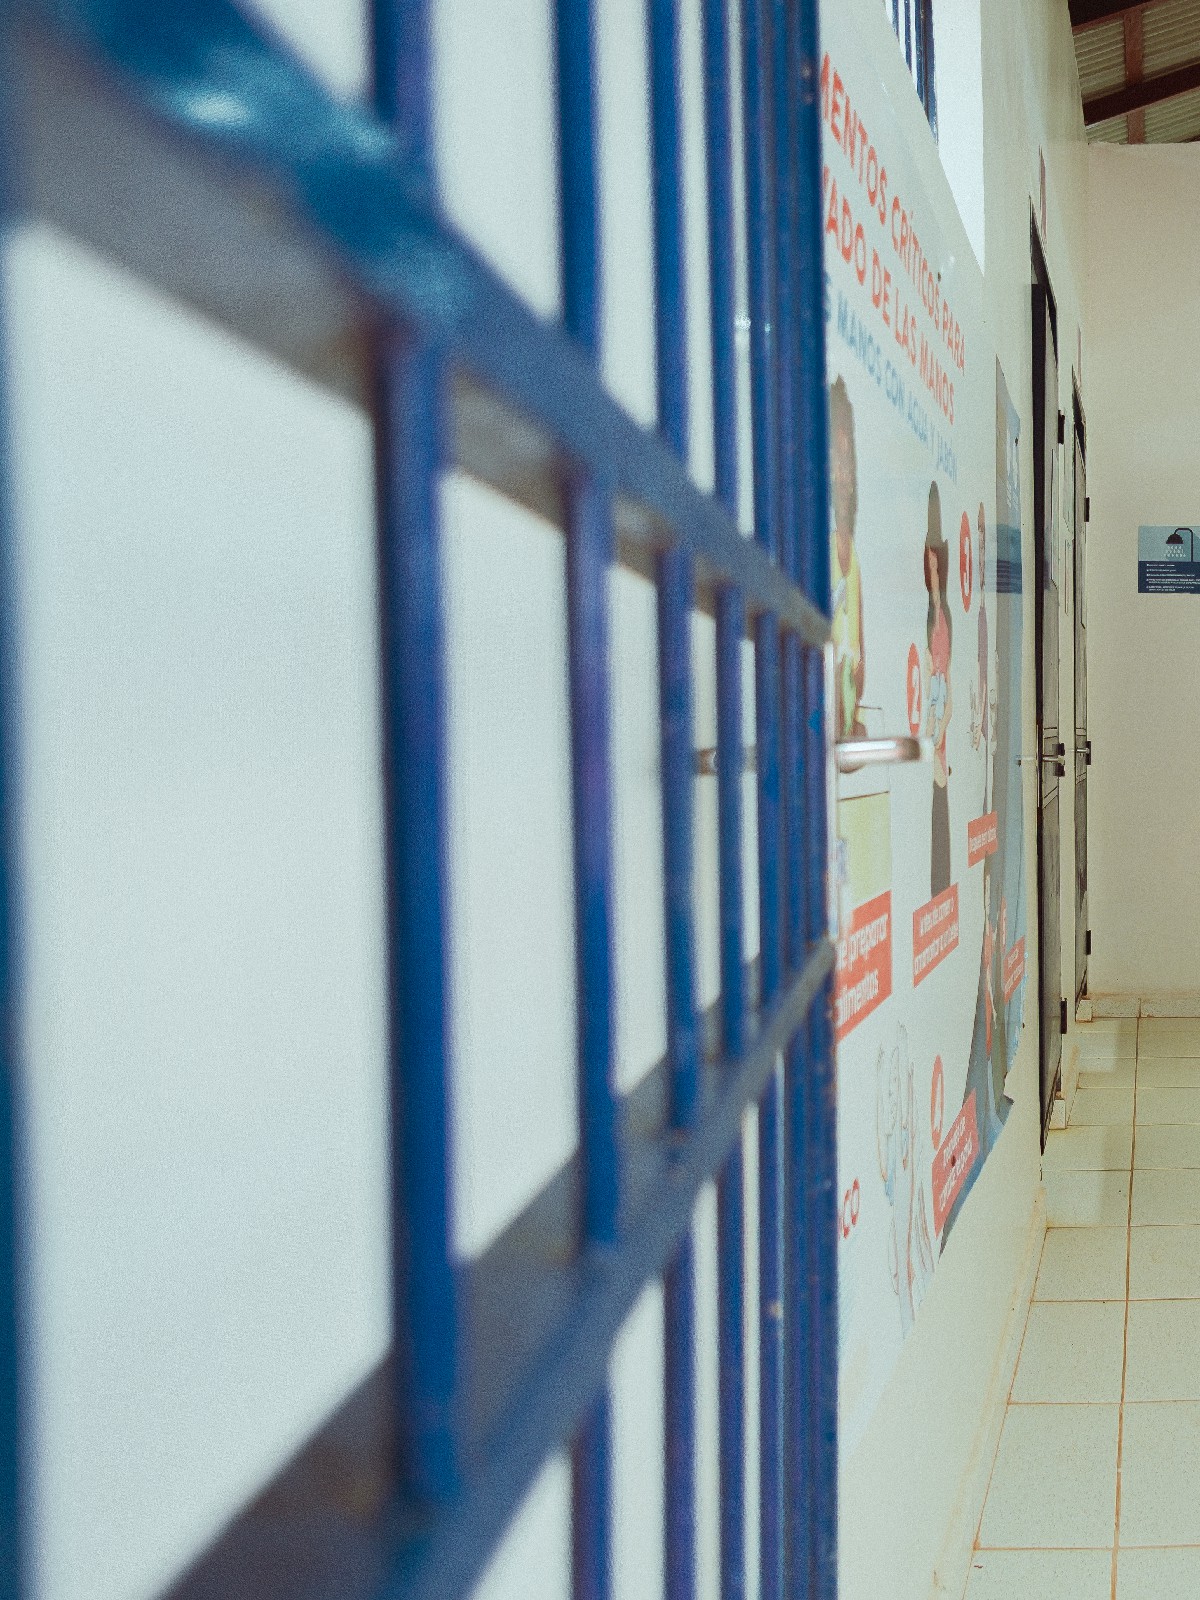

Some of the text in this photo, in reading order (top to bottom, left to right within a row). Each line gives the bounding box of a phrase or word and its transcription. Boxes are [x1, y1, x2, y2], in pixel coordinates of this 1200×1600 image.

[823, 166, 954, 424] ADO DE LAS MANOS
[892, 196, 940, 331] CRÍTICOS
[943, 299, 965, 376] PARA
[911, 665, 919, 725] 2
[848, 913, 889, 972] preparar
